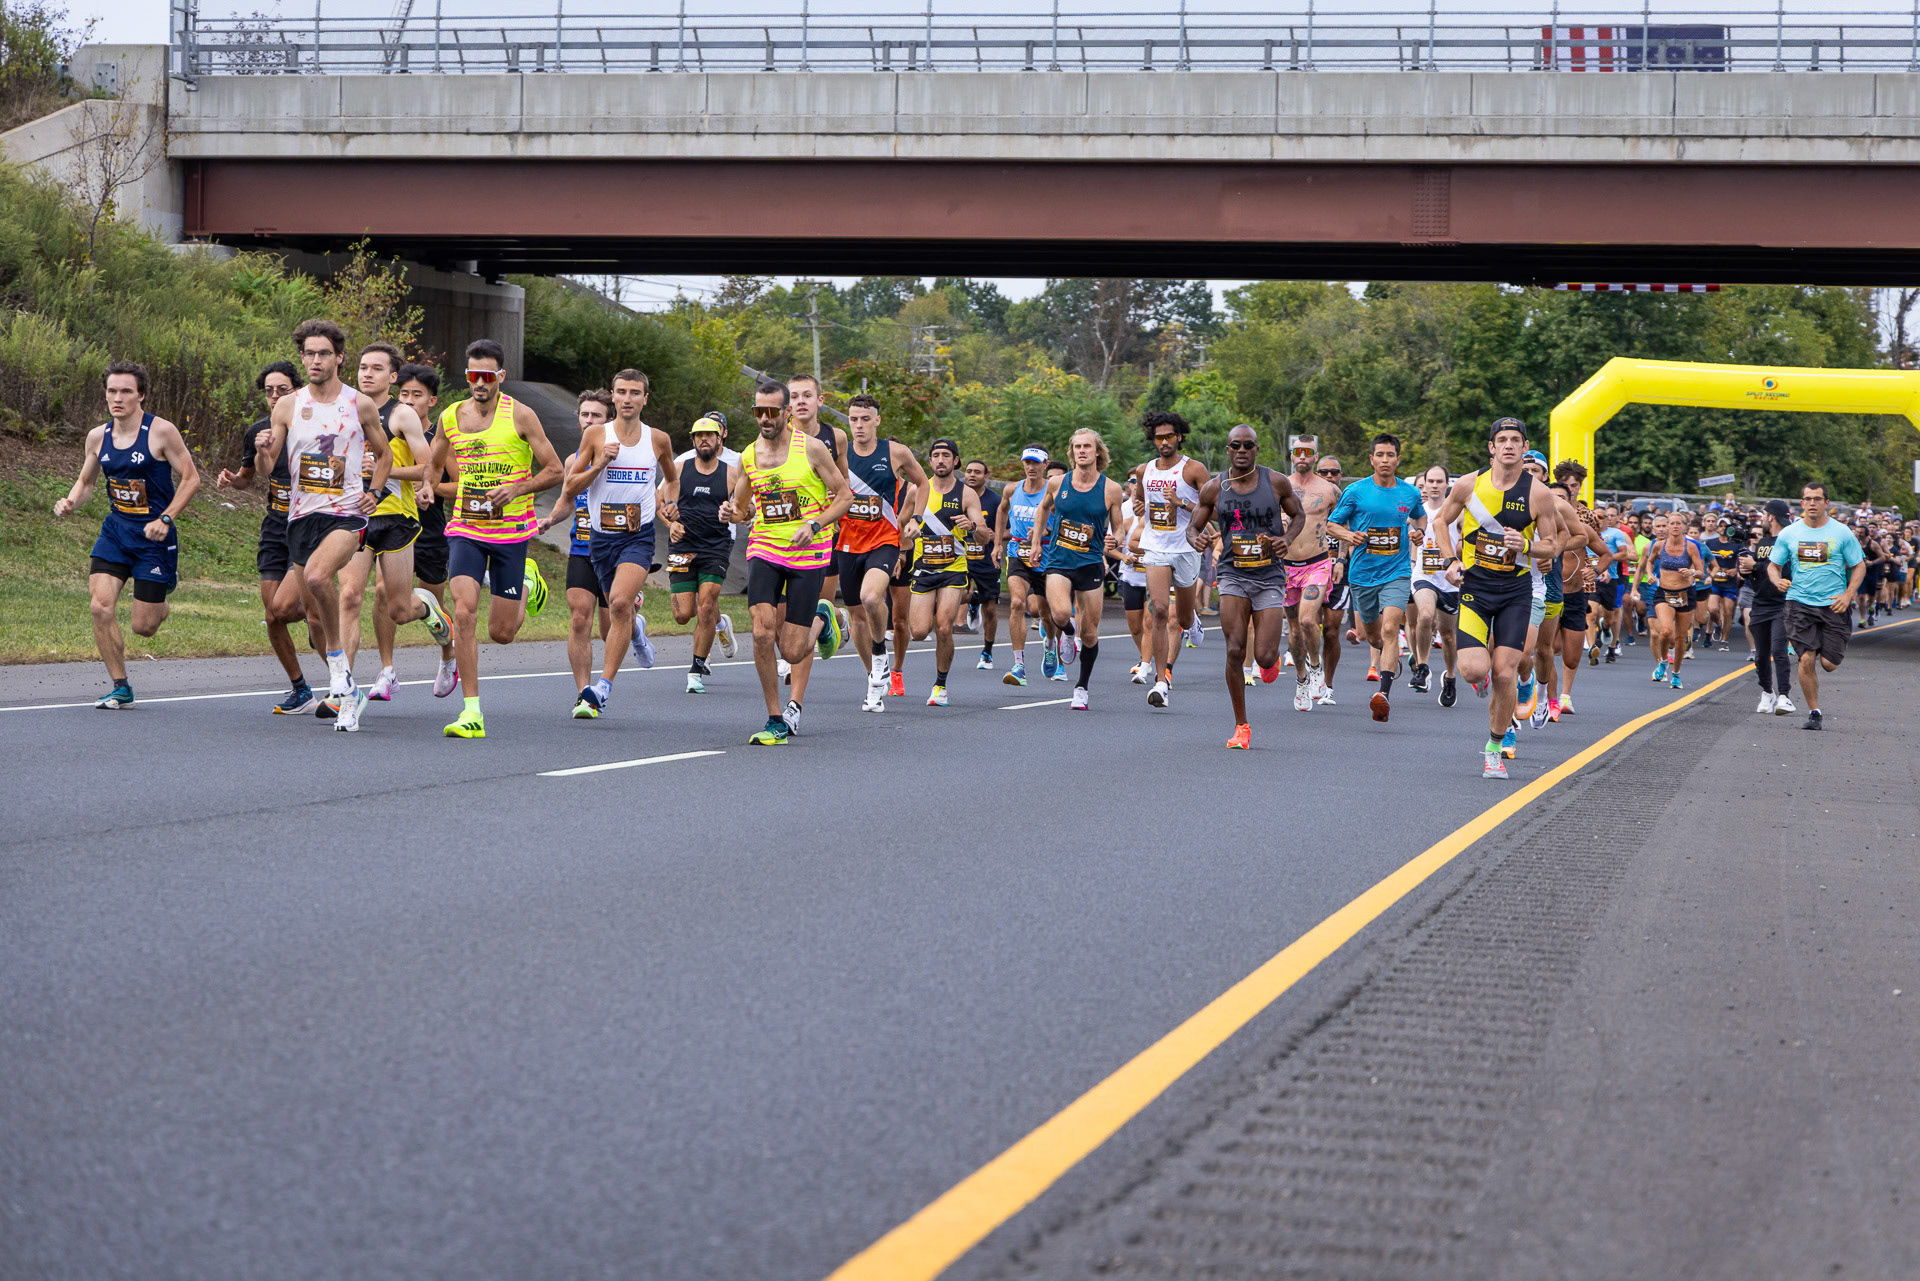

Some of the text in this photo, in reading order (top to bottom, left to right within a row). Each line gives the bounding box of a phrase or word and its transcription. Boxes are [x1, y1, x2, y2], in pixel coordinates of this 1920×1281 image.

[308, 466, 334, 480] 39
[488, 462, 514, 475] RUNNERS
[606, 470, 648, 481] SHORE A.C.
[479, 480, 502, 488] YORK
[1146, 479, 1177, 488] LEONIA
[114, 488, 140, 501] 137
[469, 500, 493, 512] 94
[765, 503, 792, 516] 217
[849, 504, 880, 515] 200
[1225, 499, 1251, 511] The
[1505, 502, 1525, 512] GSTC
[614, 515, 626, 526] 9
[1154, 511, 1170, 520] 27
[1063, 528, 1088, 542] 198
[1369, 535, 1399, 545] 233
[924, 544, 953, 553] 245
[1241, 544, 1263, 555] 75
[1485, 544, 1508, 557] 97
[1804, 549, 1822, 558] 55
[1425, 557, 1445, 566] 212
